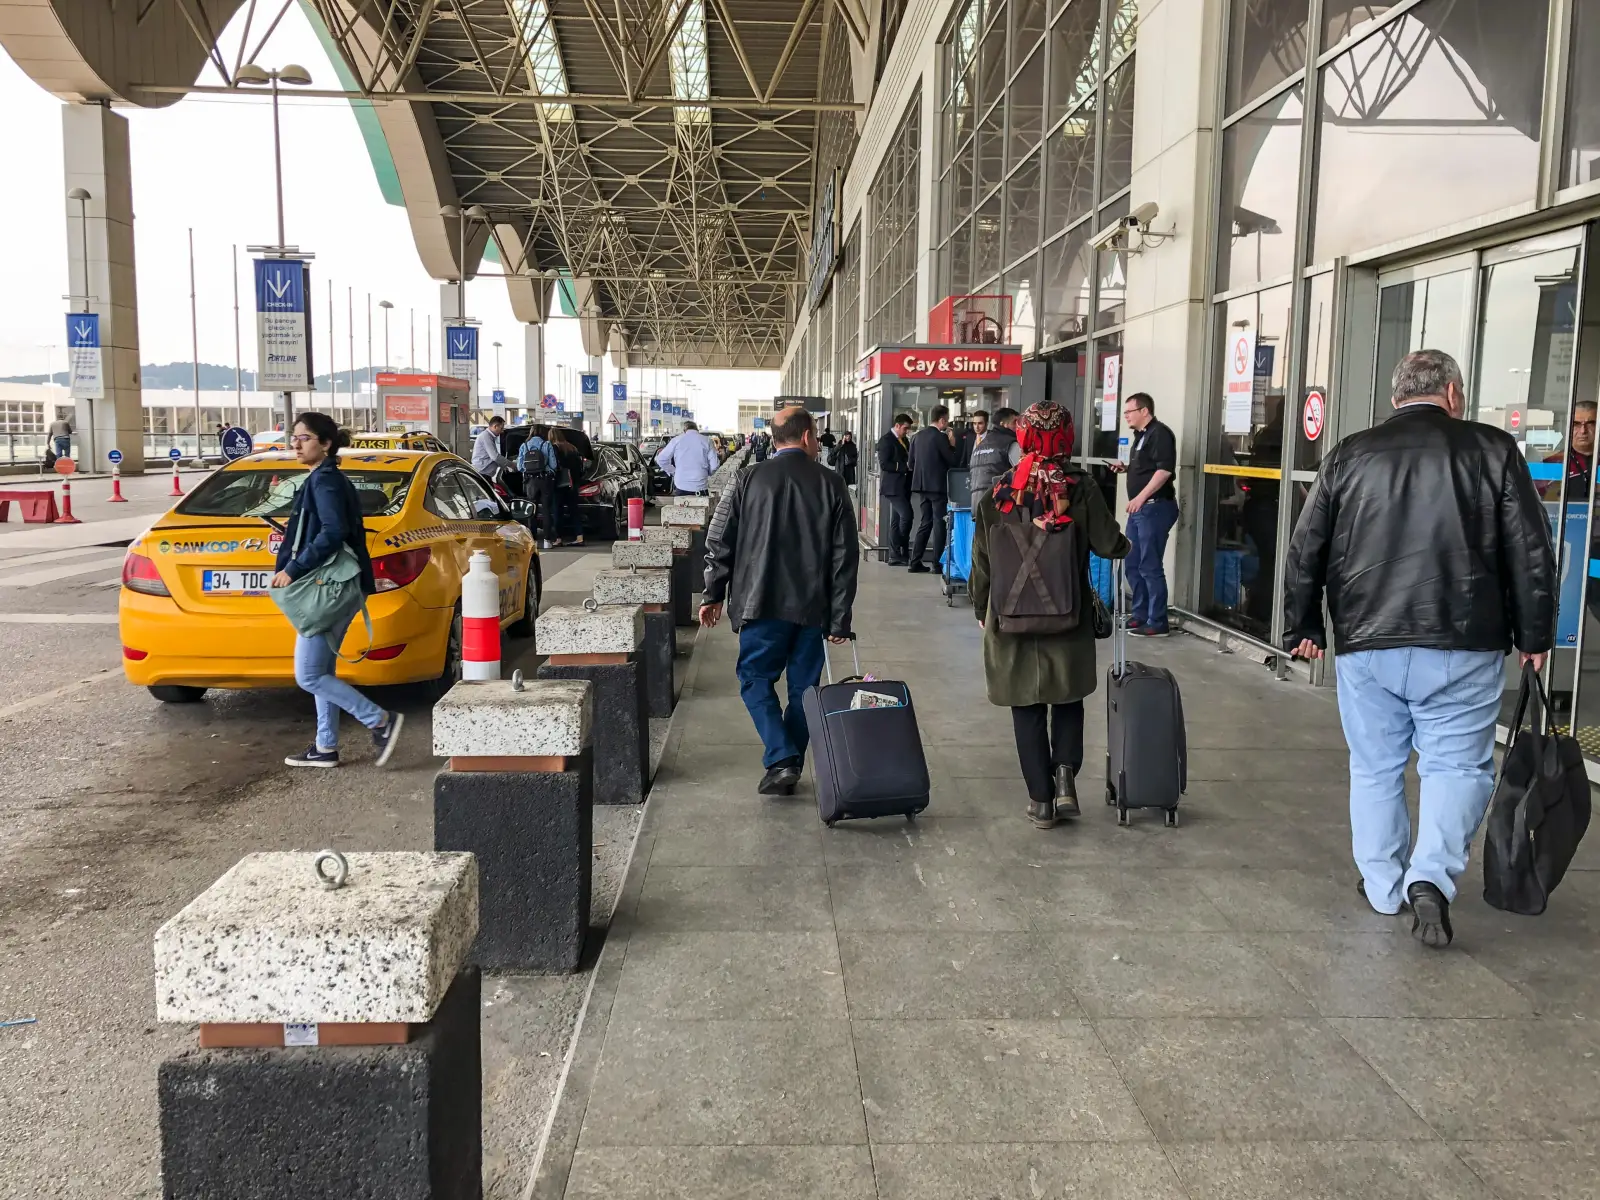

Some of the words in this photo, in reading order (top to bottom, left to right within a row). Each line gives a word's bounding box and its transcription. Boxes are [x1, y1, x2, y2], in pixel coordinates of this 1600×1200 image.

[953, 357, 998, 372] Simit
[174, 541, 239, 554] SAWKOOP
[213, 573, 231, 589] 34
[240, 573, 268, 589] TDC
